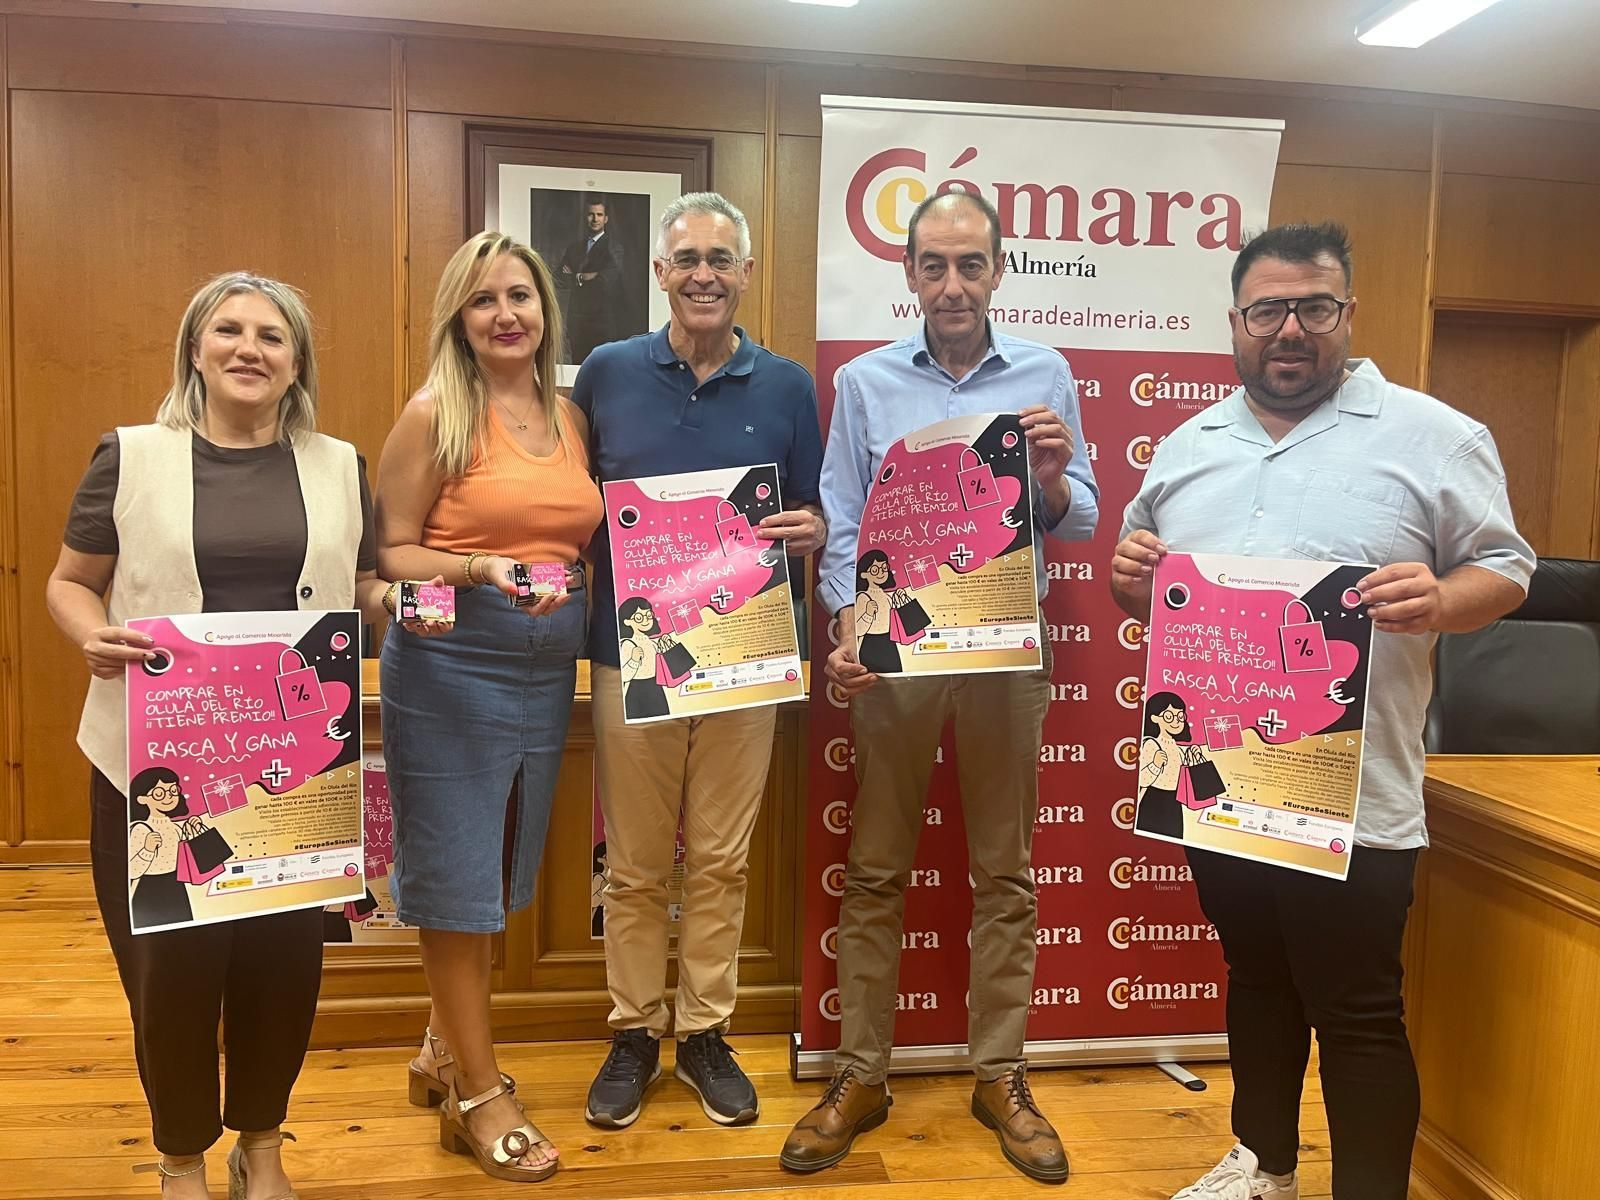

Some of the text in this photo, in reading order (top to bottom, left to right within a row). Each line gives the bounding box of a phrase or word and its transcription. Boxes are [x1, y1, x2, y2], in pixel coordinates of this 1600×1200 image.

[1004, 250, 1097, 278] Almería
[892, 303, 1190, 331] wwmaradealmeria.es
[1176, 402, 1204, 410] Almería
[875, 482, 933, 502] COMPRAR EN
[904, 493, 921, 504] DEL
[623, 532, 692, 549] COMPRAR EN
[869, 520, 977, 544] RASCA Y GANA
[624, 546, 659, 559] OLULA
[663, 543, 681, 554] DEL
[628, 564, 736, 591] RASCA Y GANA
[1227, 576, 1244, 585] Apoyo
[1251, 578, 1275, 586] Comercio
[216, 632, 235, 641] Apoyo
[242, 632, 266, 640] Comercio
[1165, 623, 1247, 640] COMPRAR EN
[1164, 635, 1203, 648] OLULA
[1209, 639, 1231, 652] DEL
[1163, 668, 1295, 701] RASCA Y GANA
[145, 685, 243, 702] COMPRAR EN
[145, 700, 194, 715] OLULA
[202, 698, 227, 711] DEL
[147, 731, 298, 759] RASCA Y GANA
[1282, 801, 1349, 818] #EuropaSeSiente
[294, 837, 357, 850] #EuropaSeSiente
[1109, 856, 1193, 890] Cáma
[1153, 883, 1181, 891] Almería
[1107, 916, 1220, 950] Cámara
[1151, 943, 1178, 951] Almería
[1106, 975, 1219, 1010] Cámara
[1149, 1002, 1176, 1010] Almería
